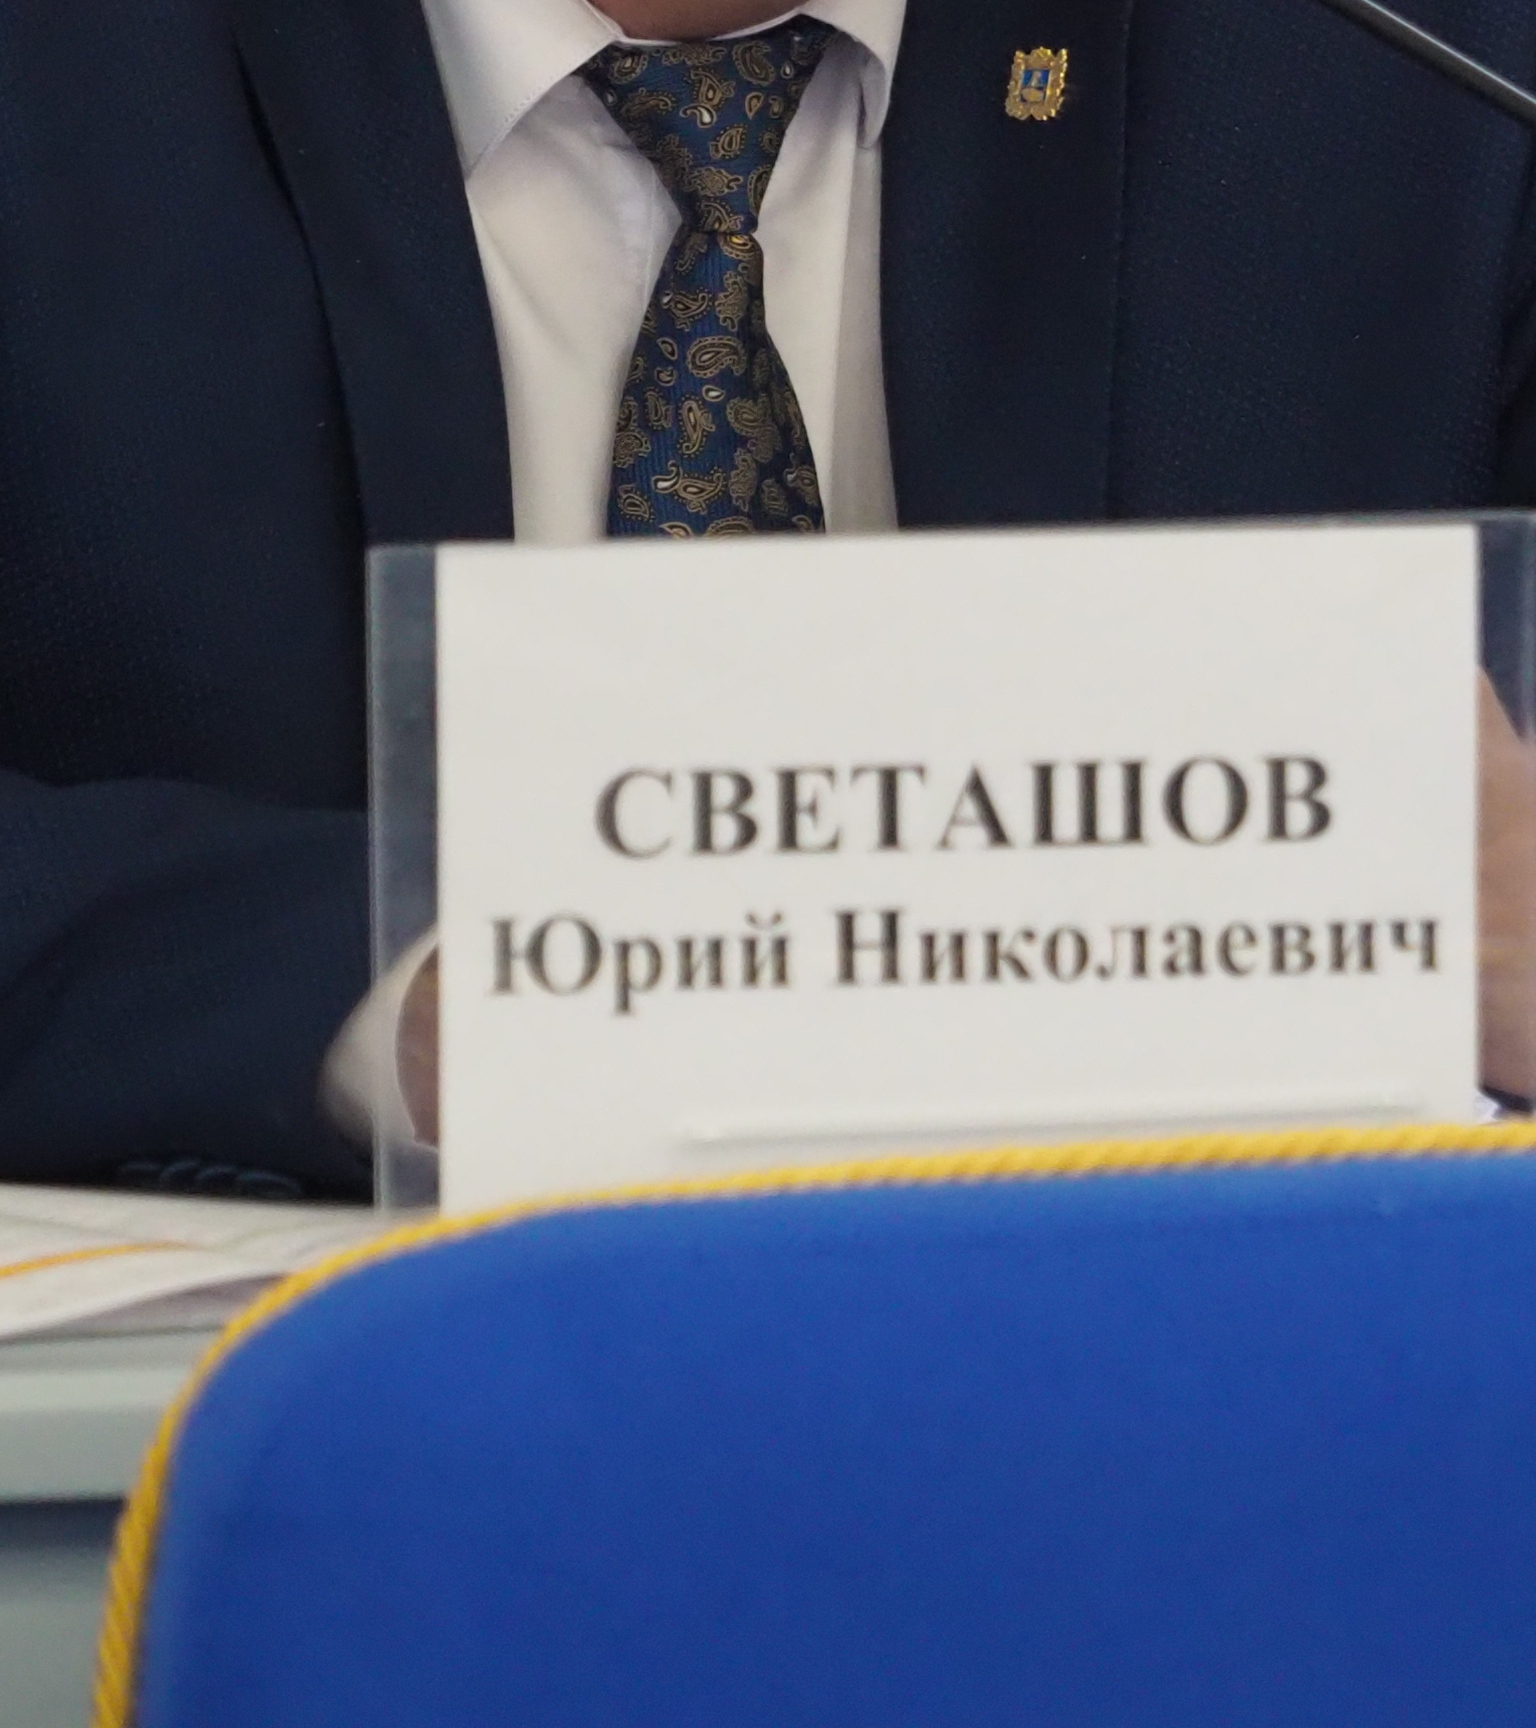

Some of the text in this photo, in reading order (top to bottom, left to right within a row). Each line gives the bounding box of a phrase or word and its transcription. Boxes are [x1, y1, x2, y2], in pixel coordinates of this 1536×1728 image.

[594, 754, 1334, 860] СВЕТАШОВ
[486, 908, 1441, 1016] Юрий Николаевич
